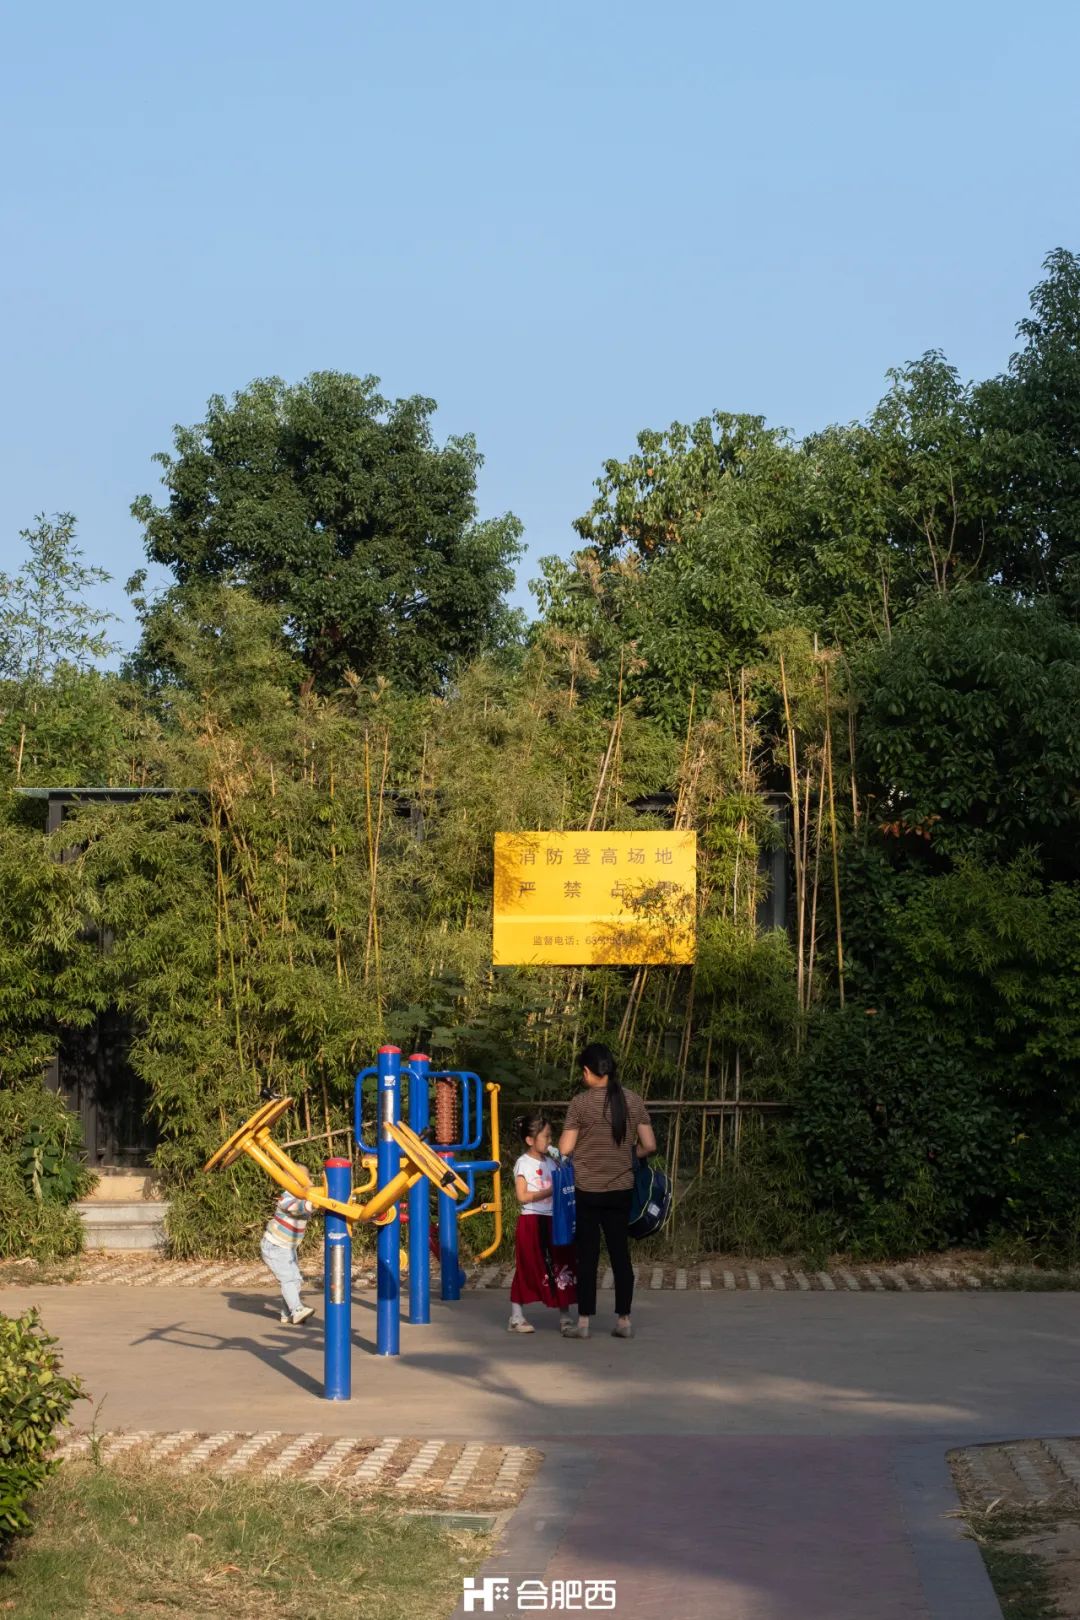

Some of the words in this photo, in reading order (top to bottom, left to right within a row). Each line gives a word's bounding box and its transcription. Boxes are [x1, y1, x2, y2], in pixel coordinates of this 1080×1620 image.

[519, 847, 673, 866] 消防登高场地
